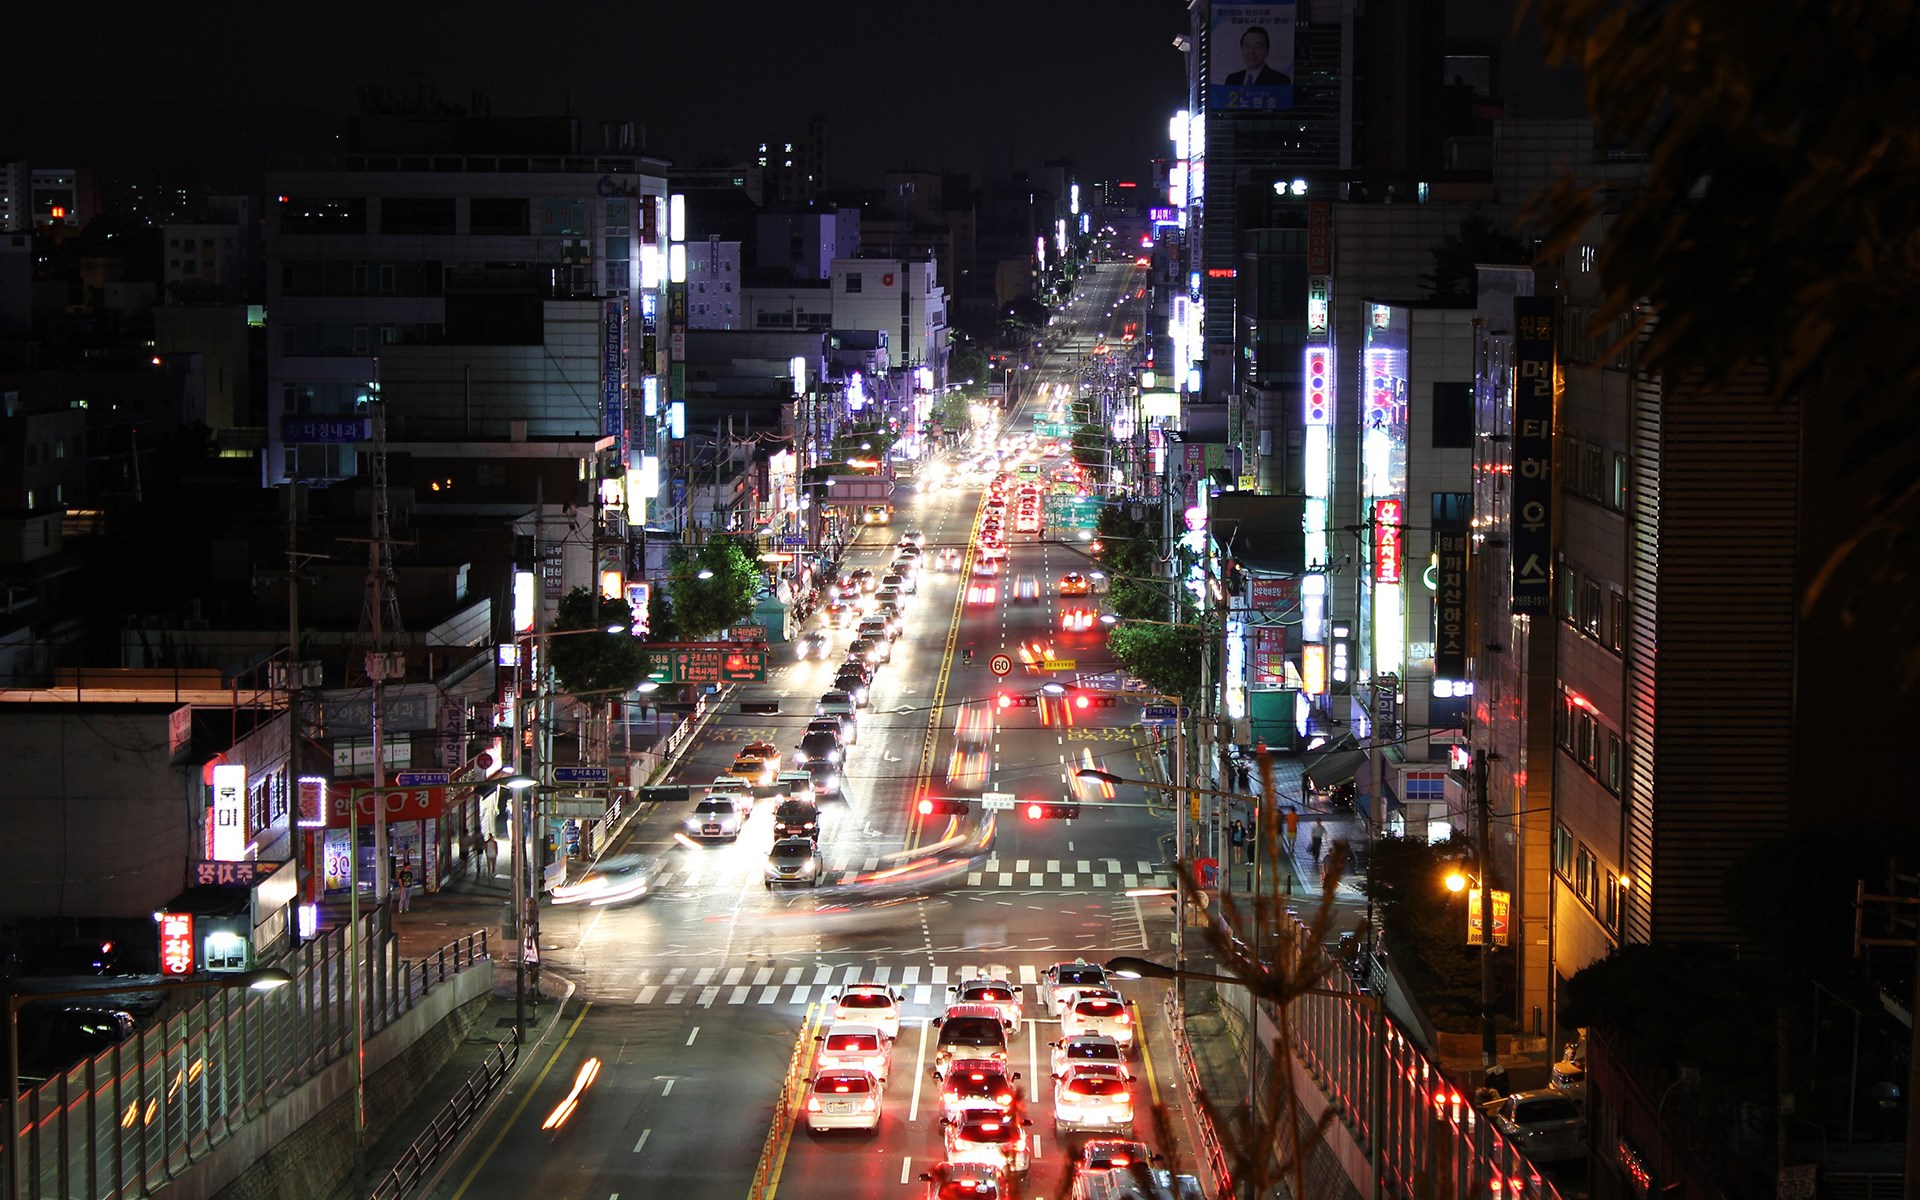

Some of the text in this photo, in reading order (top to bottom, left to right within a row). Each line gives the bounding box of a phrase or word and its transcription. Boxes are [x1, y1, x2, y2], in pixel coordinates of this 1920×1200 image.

[1228, 91, 1238, 109] 2
[1519, 315, 1552, 341] 원룸
[304, 423, 358, 438] 다정내과
[1443, 555, 1463, 656] 까치산하우스
[731, 627, 763, 637] 화곡터널입구
[688, 667, 718, 675] 화곡사거리
[993, 659, 1009, 671] 60
[325, 700, 414, 725] 소아청년과
[414, 790, 430, 808] 경
[164, 920, 192, 974] 주차장
